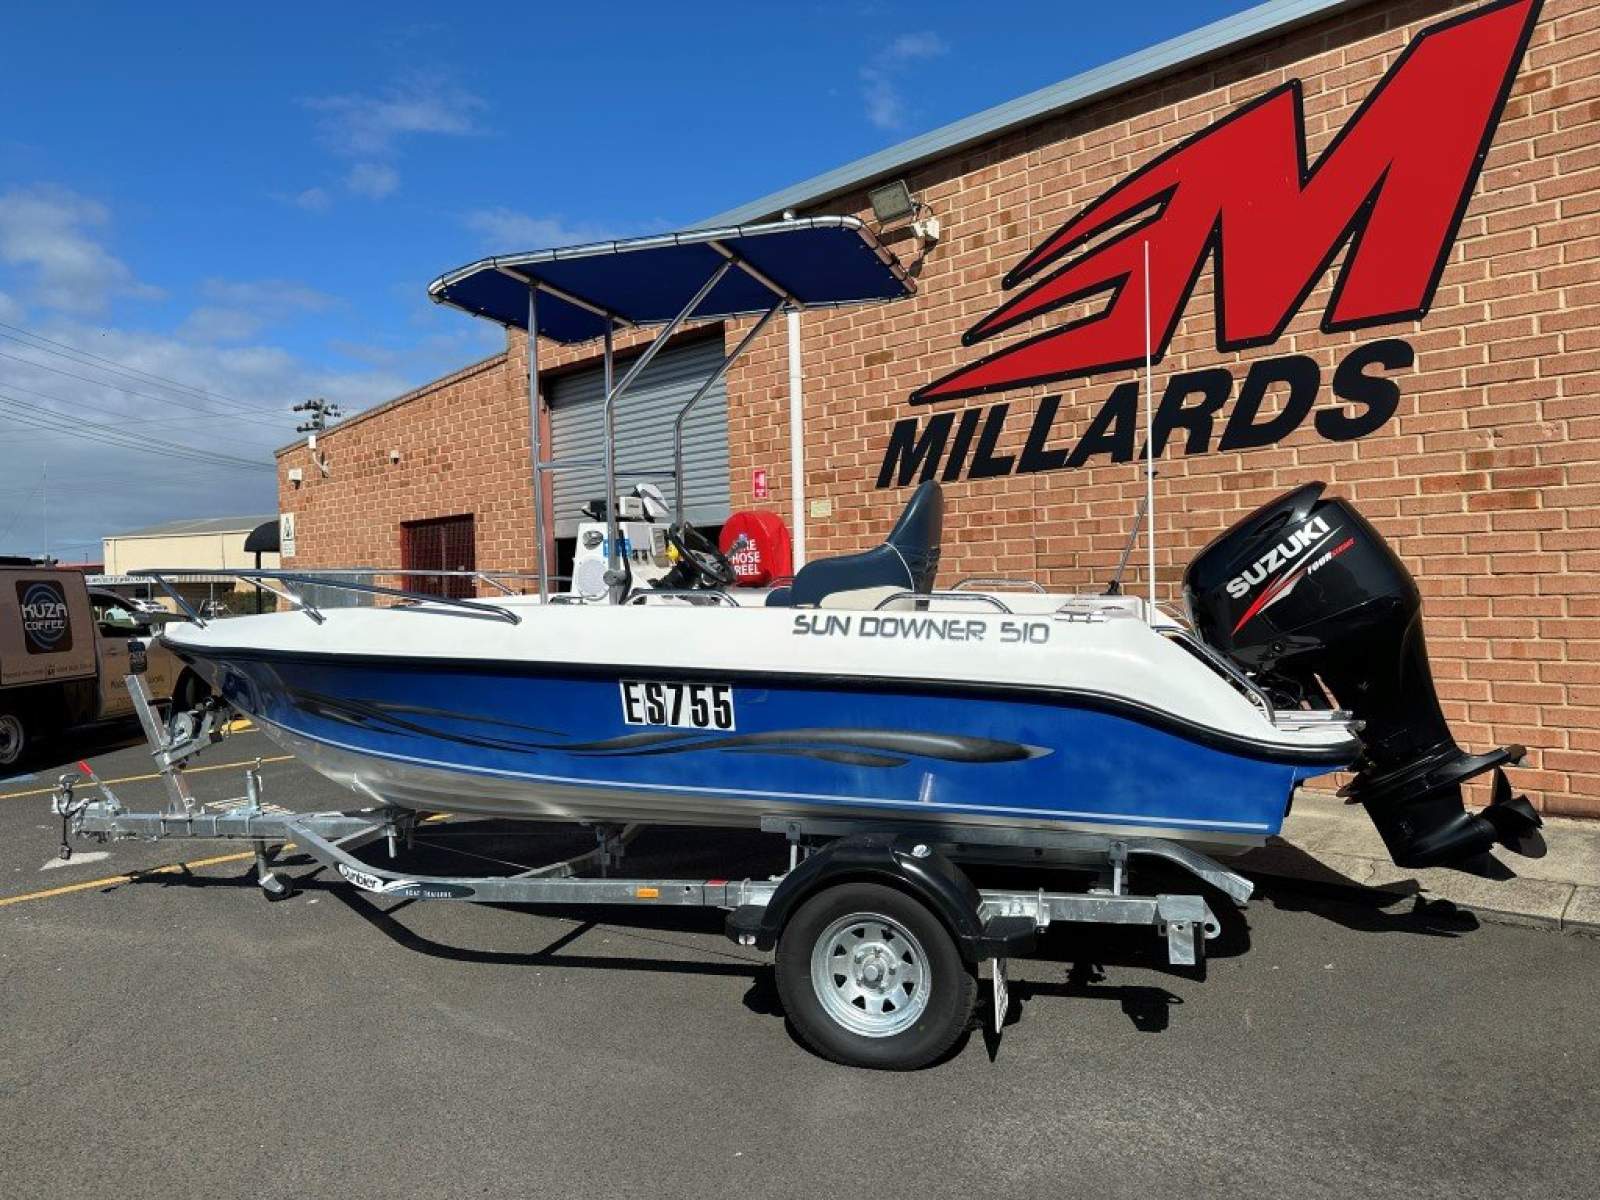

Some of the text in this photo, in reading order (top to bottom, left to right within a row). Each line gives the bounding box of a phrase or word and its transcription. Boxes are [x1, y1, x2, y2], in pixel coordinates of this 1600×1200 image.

[875, 338, 1415, 488] MILLARDS
[732, 551, 760, 564] HOSE
[734, 563, 761, 576] REEL
[1226, 516, 1331, 600] SUZUKI
[25, 620, 64, 631] COFFEE
[792, 614, 1050, 645] SUN DOWNER 510
[622, 681, 732, 729] ES755
